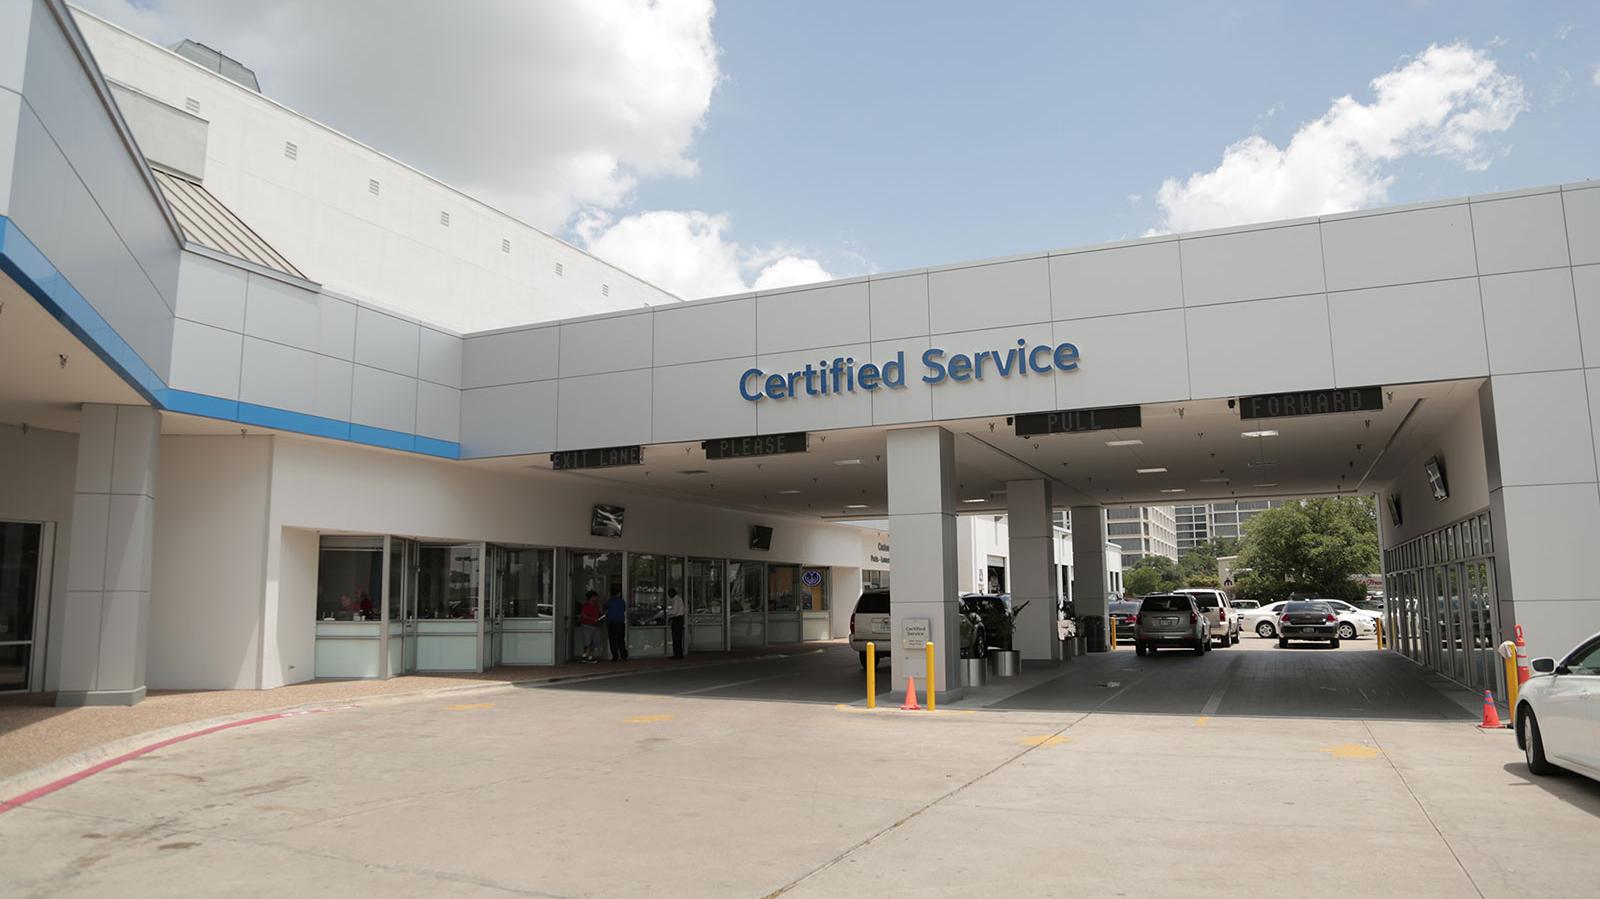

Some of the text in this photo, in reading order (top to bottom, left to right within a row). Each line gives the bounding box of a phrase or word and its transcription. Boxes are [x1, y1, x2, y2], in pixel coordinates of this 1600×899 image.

[739, 338, 1081, 401] Certified Service
[1252, 390, 1363, 417] FORWARD
[1048, 409, 1100, 432] PULL
[553, 447, 638, 469] EXIT LANE
[720, 436, 786, 457] PLEASE
